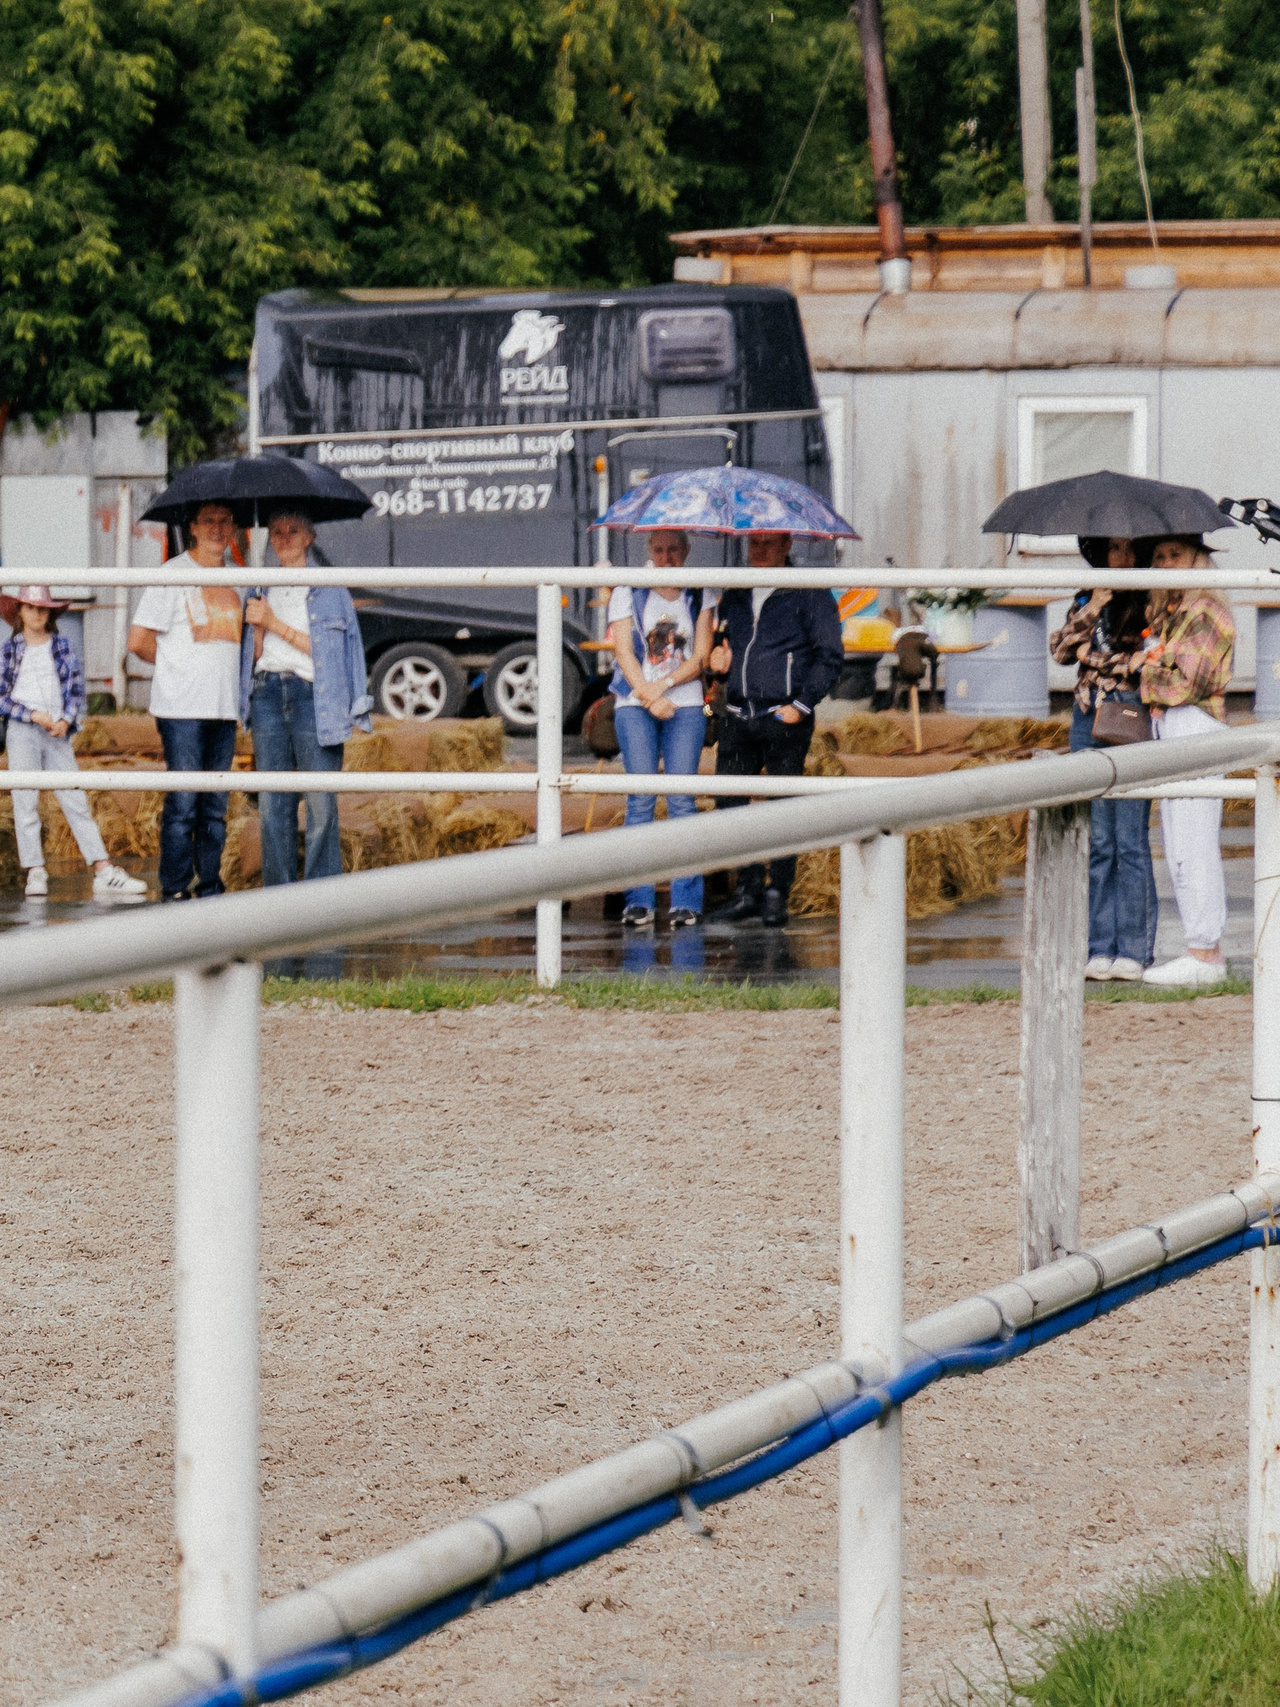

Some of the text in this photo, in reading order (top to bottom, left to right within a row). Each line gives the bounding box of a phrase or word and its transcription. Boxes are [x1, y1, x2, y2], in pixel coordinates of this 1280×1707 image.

[501, 364, 569, 393] РЕЙД
[318, 429, 575, 464] Конно-спортивный клуб
